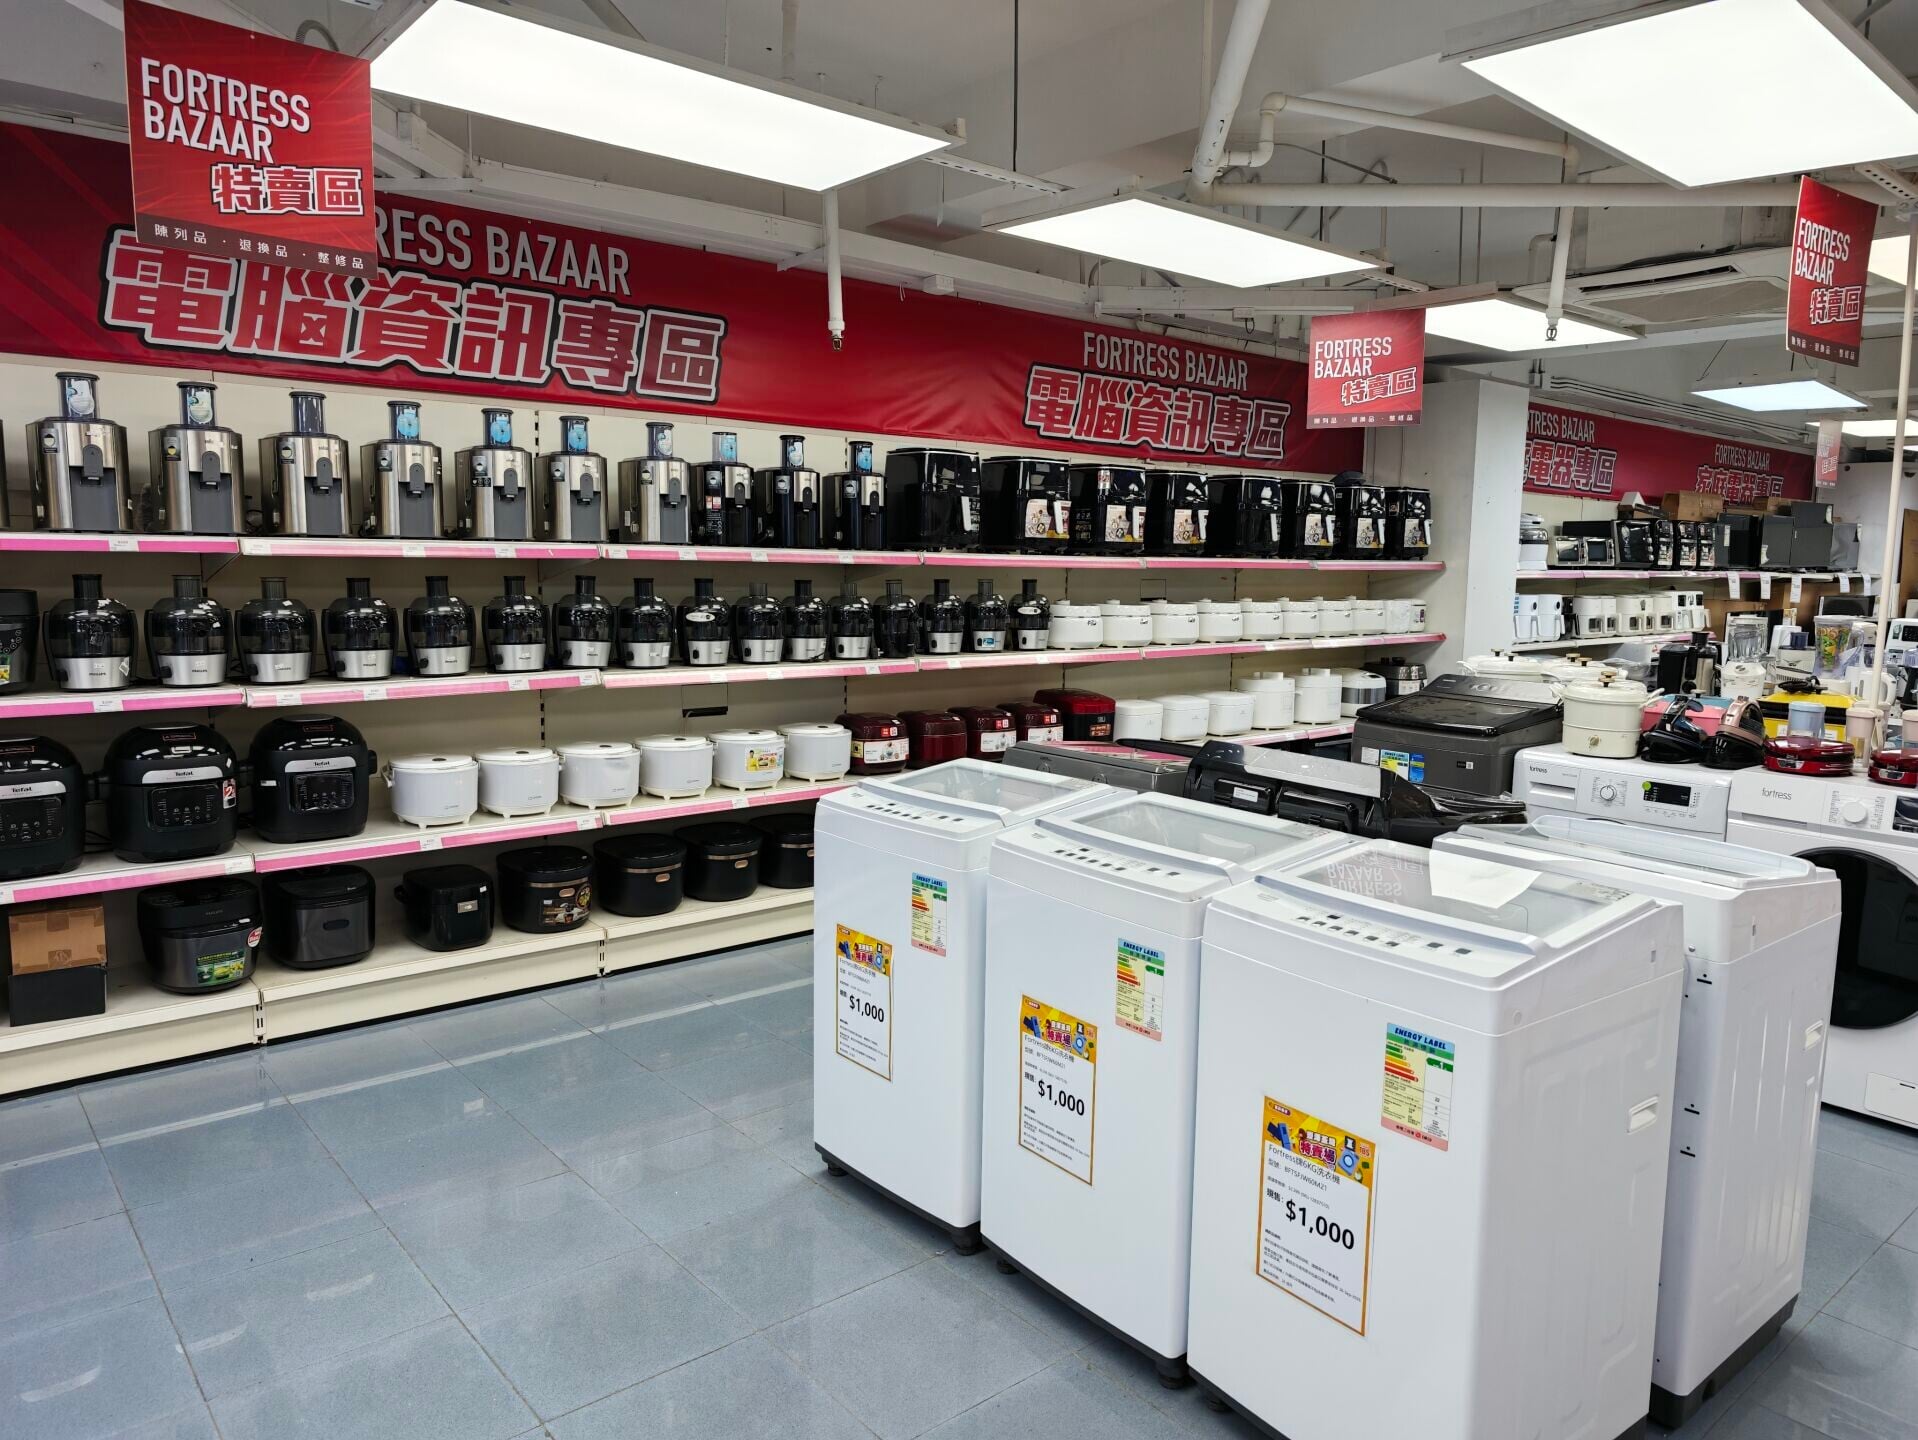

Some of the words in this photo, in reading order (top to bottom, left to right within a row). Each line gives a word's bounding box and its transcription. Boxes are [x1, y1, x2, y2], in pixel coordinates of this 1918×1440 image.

[141, 57, 312, 134] FORTRESS
[143, 98, 275, 165] BAZAAR
[212, 163, 365, 216] 特賣區
[154, 223, 207, 244] 陳列品
[239, 237, 288, 257] 退換品
[317, 251, 364, 270] 整修品
[374, 207, 473, 271] RESS
[486, 224, 631, 297] BAZAAR
[1797, 217, 1851, 262] FORTRESS
[1795, 247, 1835, 286] BAZAAR
[1810, 285, 1862, 325] 特賣區
[1083, 331, 1181, 380] FORTRESS
[1185, 349, 1249, 392] BAZAAR
[1314, 336, 1393, 360] FORTRESS
[1314, 357, 1373, 379] BAZAAR
[1341, 366, 1417, 407] 特賣區
[1024, 364, 1292, 461] 電腦資訊專區
[1528, 409, 1559, 438] TRESS
[1562, 415, 1595, 443] BAZAAR
[1714, 443, 1747, 469] FORTRESS
[1748, 449, 1770, 471] BAZAAR
[1529, 765, 1548, 774] fortress
[1761, 788, 1792, 801] fortress
[1123, 941, 1143, 952] ENERGY
[1143, 947, 1159, 958] LABEL
[849, 994, 885, 1023] $1,000
[1394, 1027, 1422, 1042] ENERGY
[1424, 1036, 1446, 1050] LABEL
[1038, 1079, 1085, 1116] $1,000
[1285, 1198, 1355, 1250] $1,000
